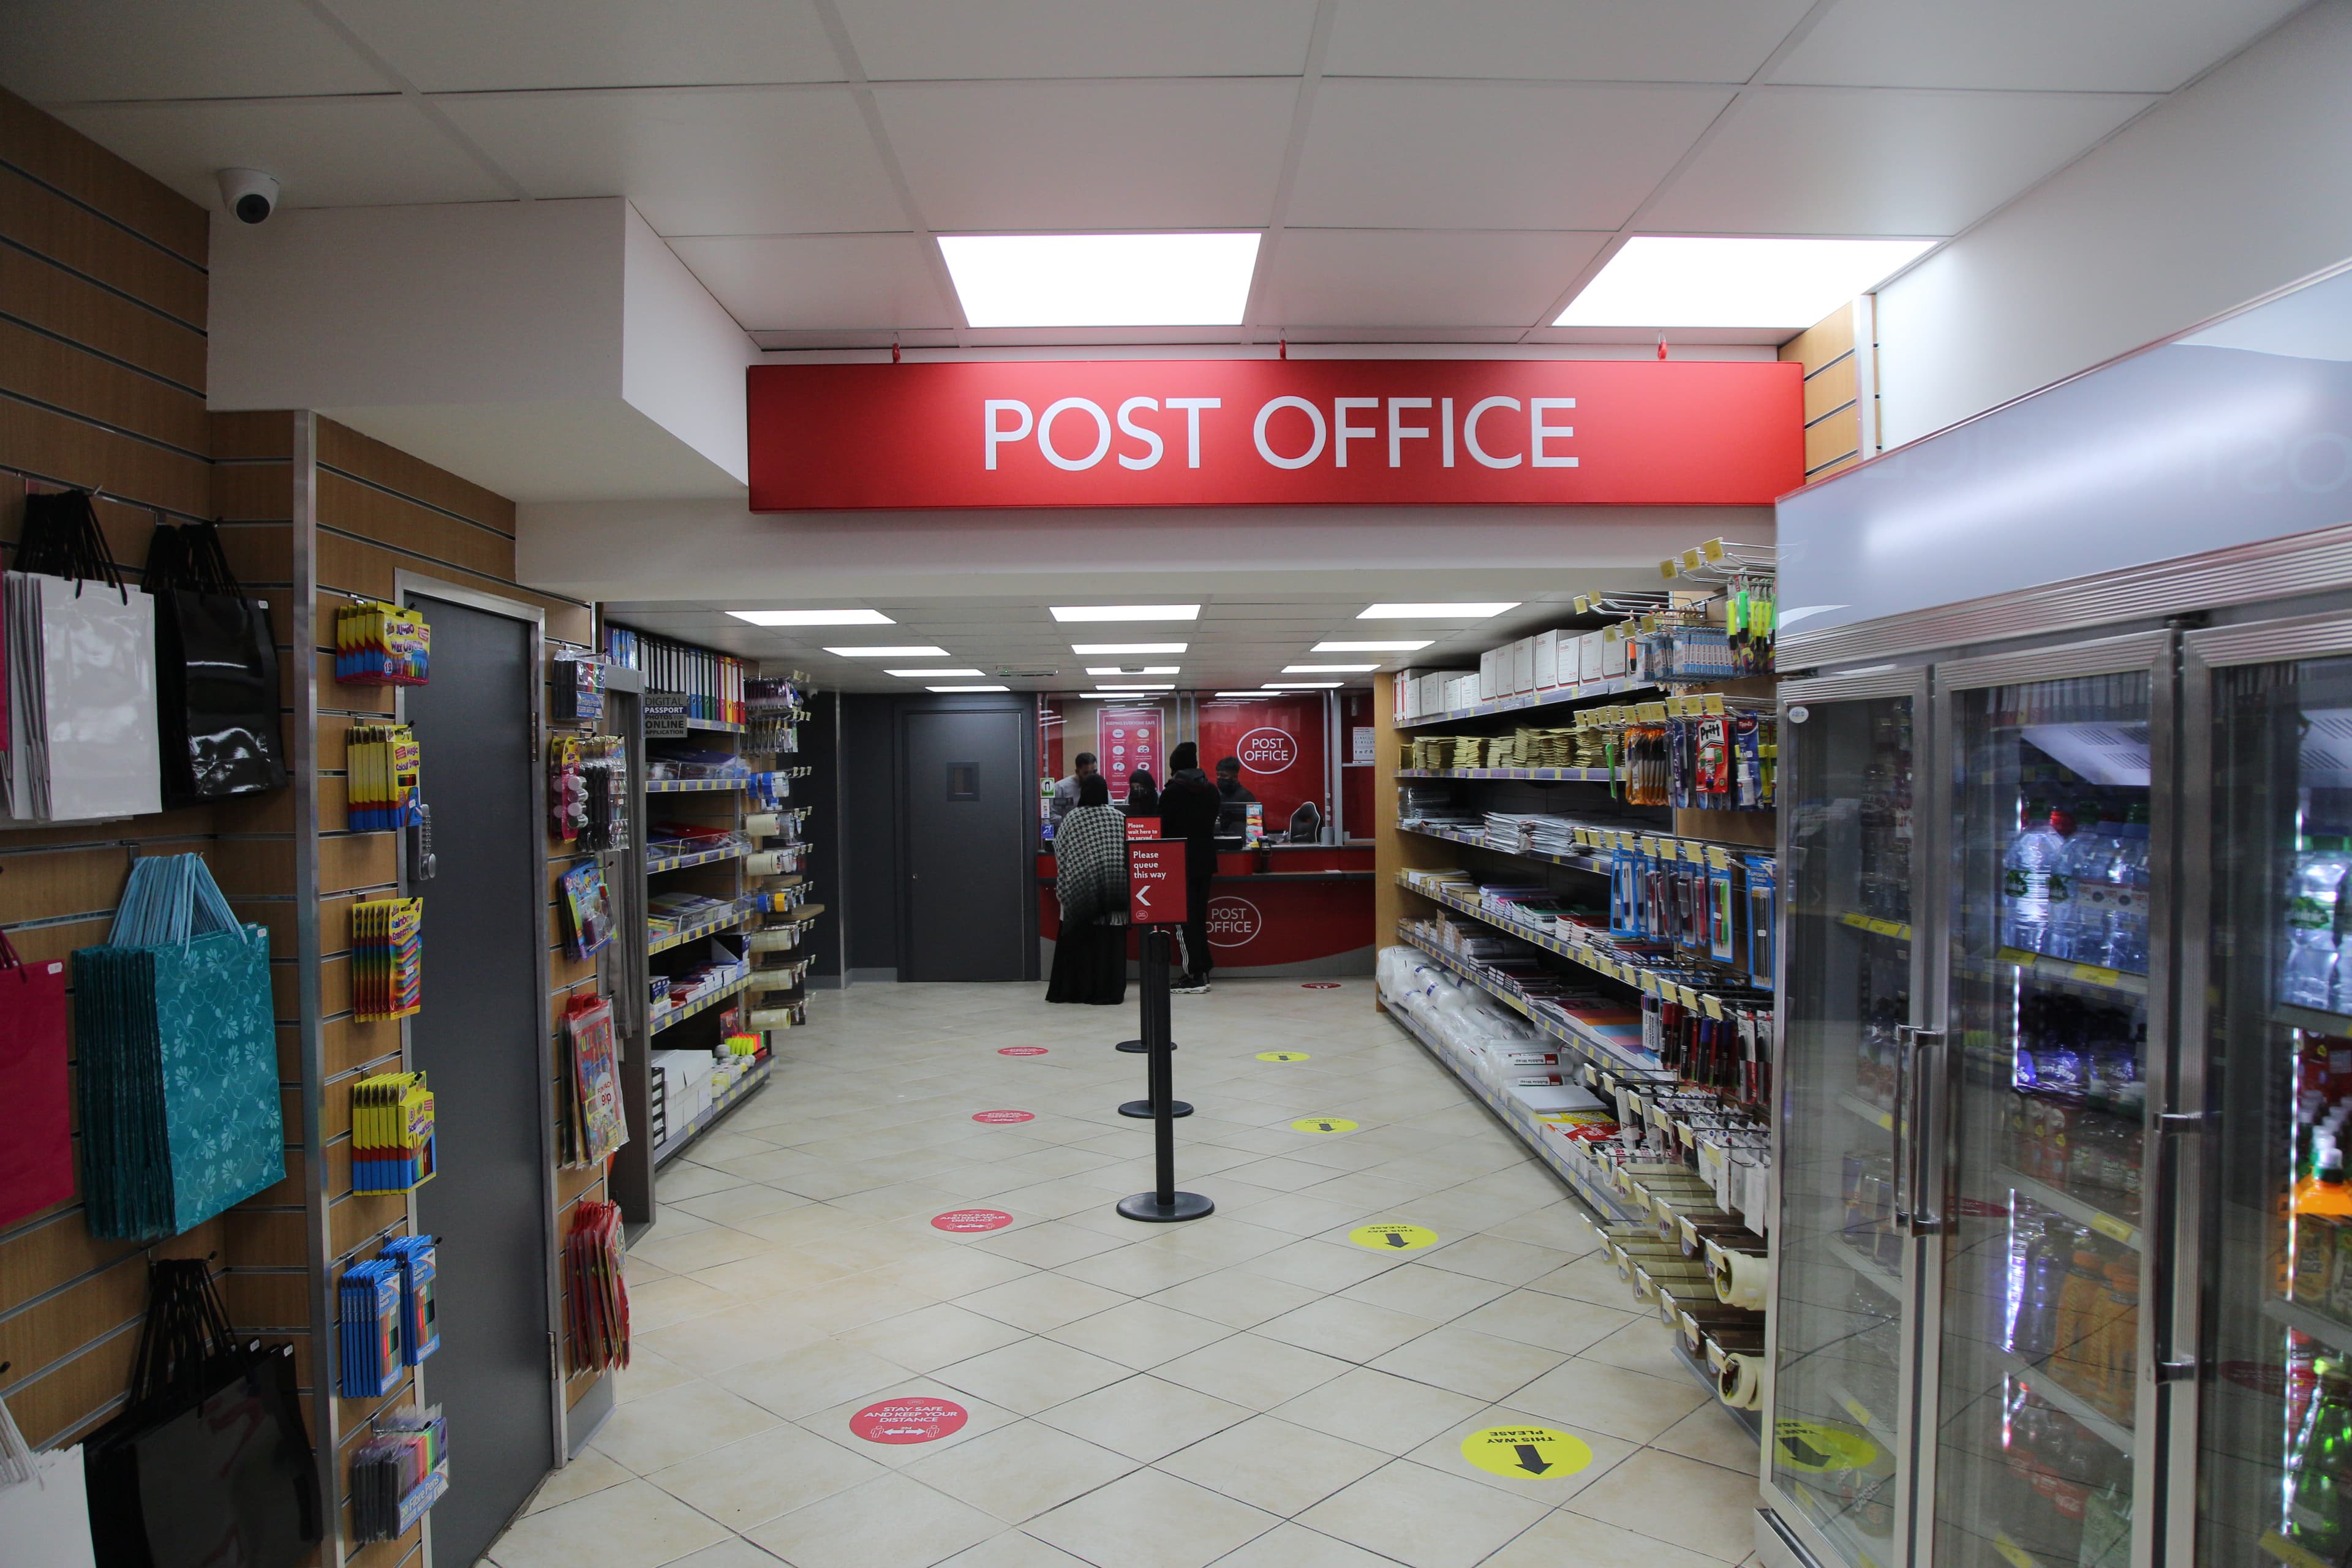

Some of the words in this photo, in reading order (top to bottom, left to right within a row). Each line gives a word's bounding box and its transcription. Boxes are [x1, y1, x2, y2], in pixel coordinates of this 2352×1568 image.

[984, 397, 1221, 470] POST
[1253, 395, 1579, 469] OFFICE
[396, 623, 414, 635] JUMBO
[391, 641, 402, 654] Wax
[385, 662, 392, 672] 12
[645, 697, 683, 706] DIGITAL
[1700, 724, 1721, 741] Pritt
[1251, 738, 1284, 748] POST
[1245, 750, 1289, 761] OFFICE
[1134, 862, 1158, 872] queue
[415, 902, 420, 913] 4
[1212, 908, 1246, 919] POST
[2036, 1063, 2076, 1082] apri-Sun
[409, 1115, 424, 1133] Scented
[409, 1491, 425, 1512] Fibre
[425, 1475, 439, 1493] Pens
